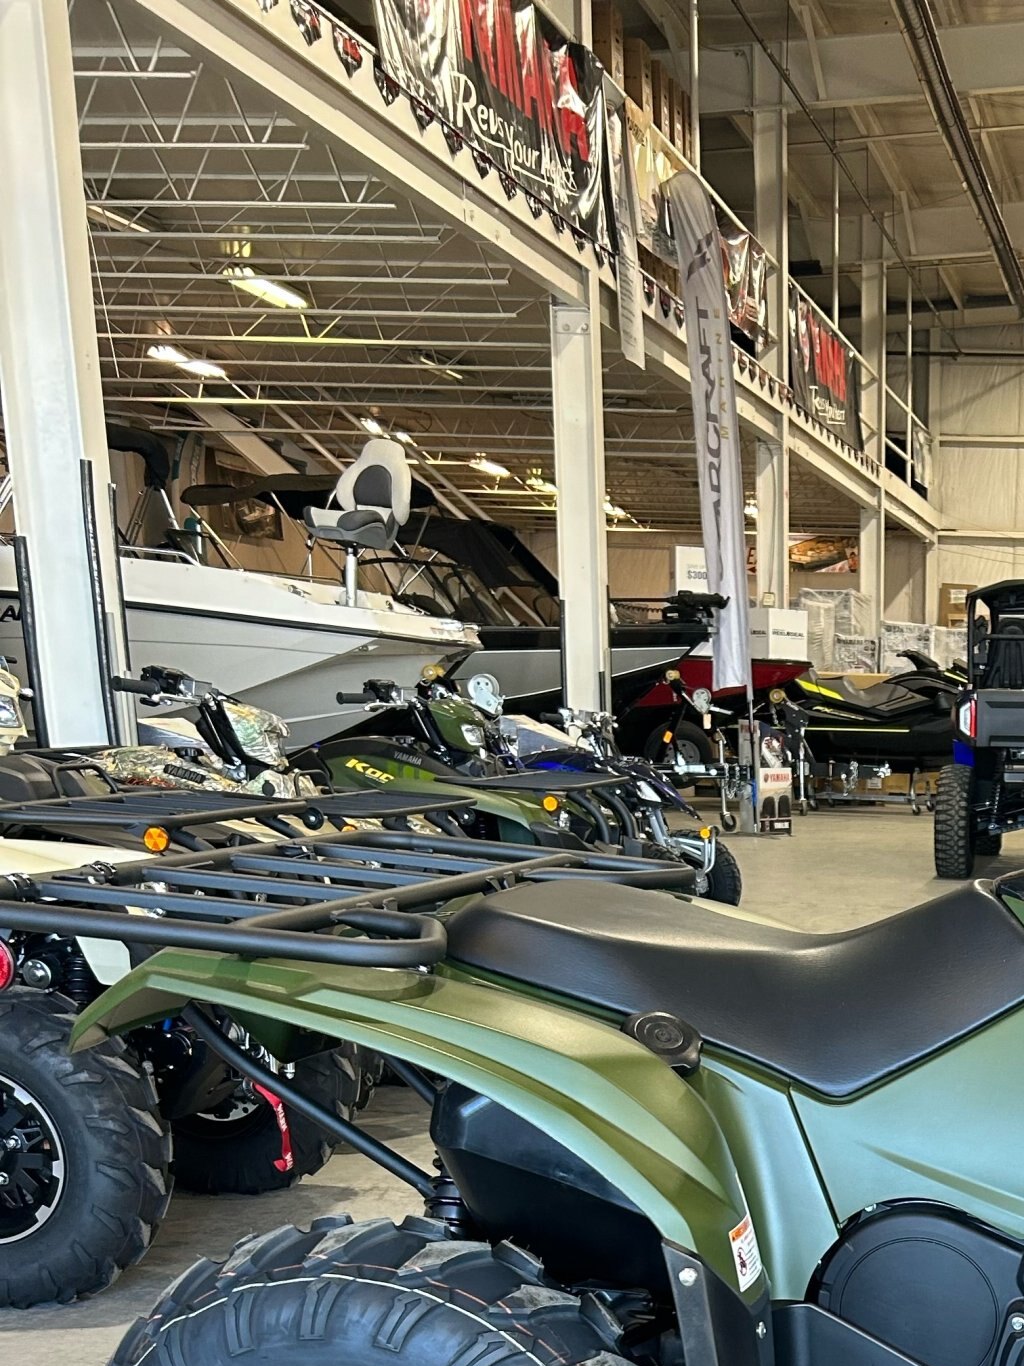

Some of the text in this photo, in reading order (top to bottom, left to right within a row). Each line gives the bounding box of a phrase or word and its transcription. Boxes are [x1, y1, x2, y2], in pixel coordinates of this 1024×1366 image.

[713, 308, 730, 440] MARINE
[393, 750, 422, 766] YAMAHA
[167, 764, 202, 783] YAMAHA
